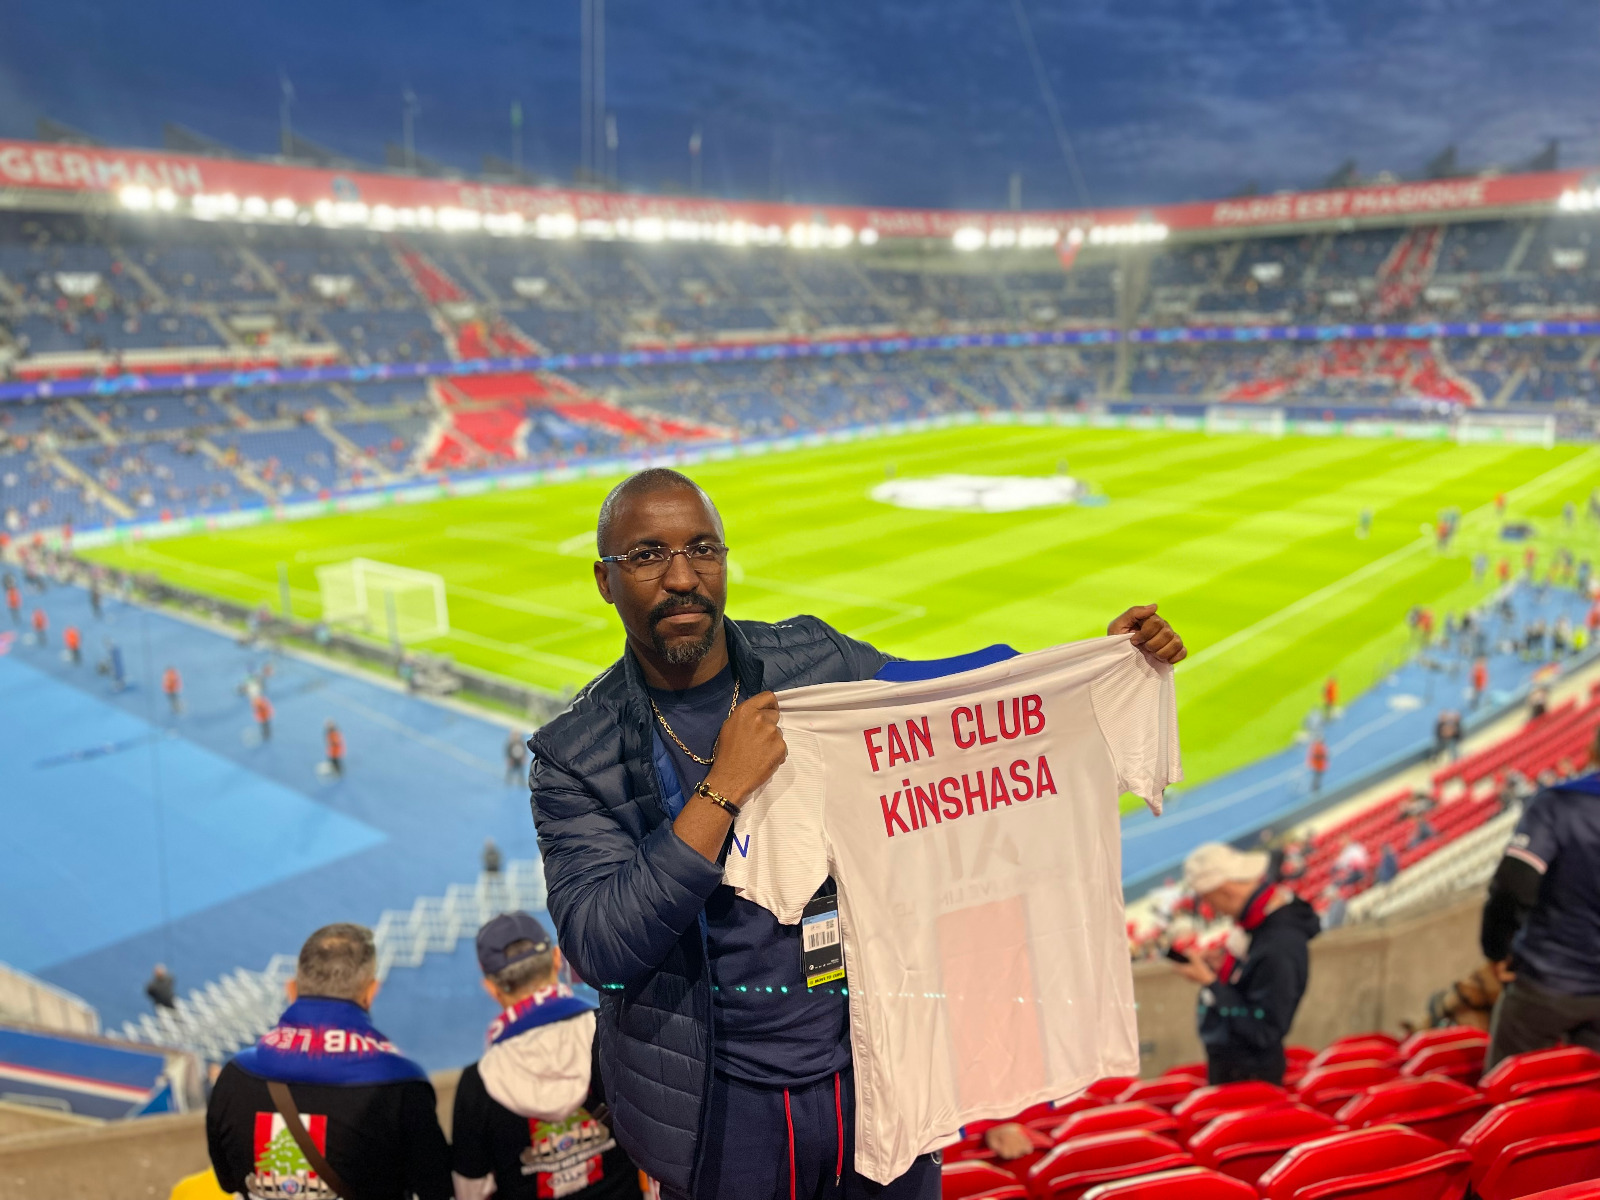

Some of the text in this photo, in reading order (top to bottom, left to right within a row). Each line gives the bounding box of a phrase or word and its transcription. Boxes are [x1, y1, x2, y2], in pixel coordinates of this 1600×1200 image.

[0, 149, 203, 194] GERMAIN
[1213, 180, 1488, 222] PARIS EST MAGIQUE
[863, 694, 1046, 772] FAN CLUB
